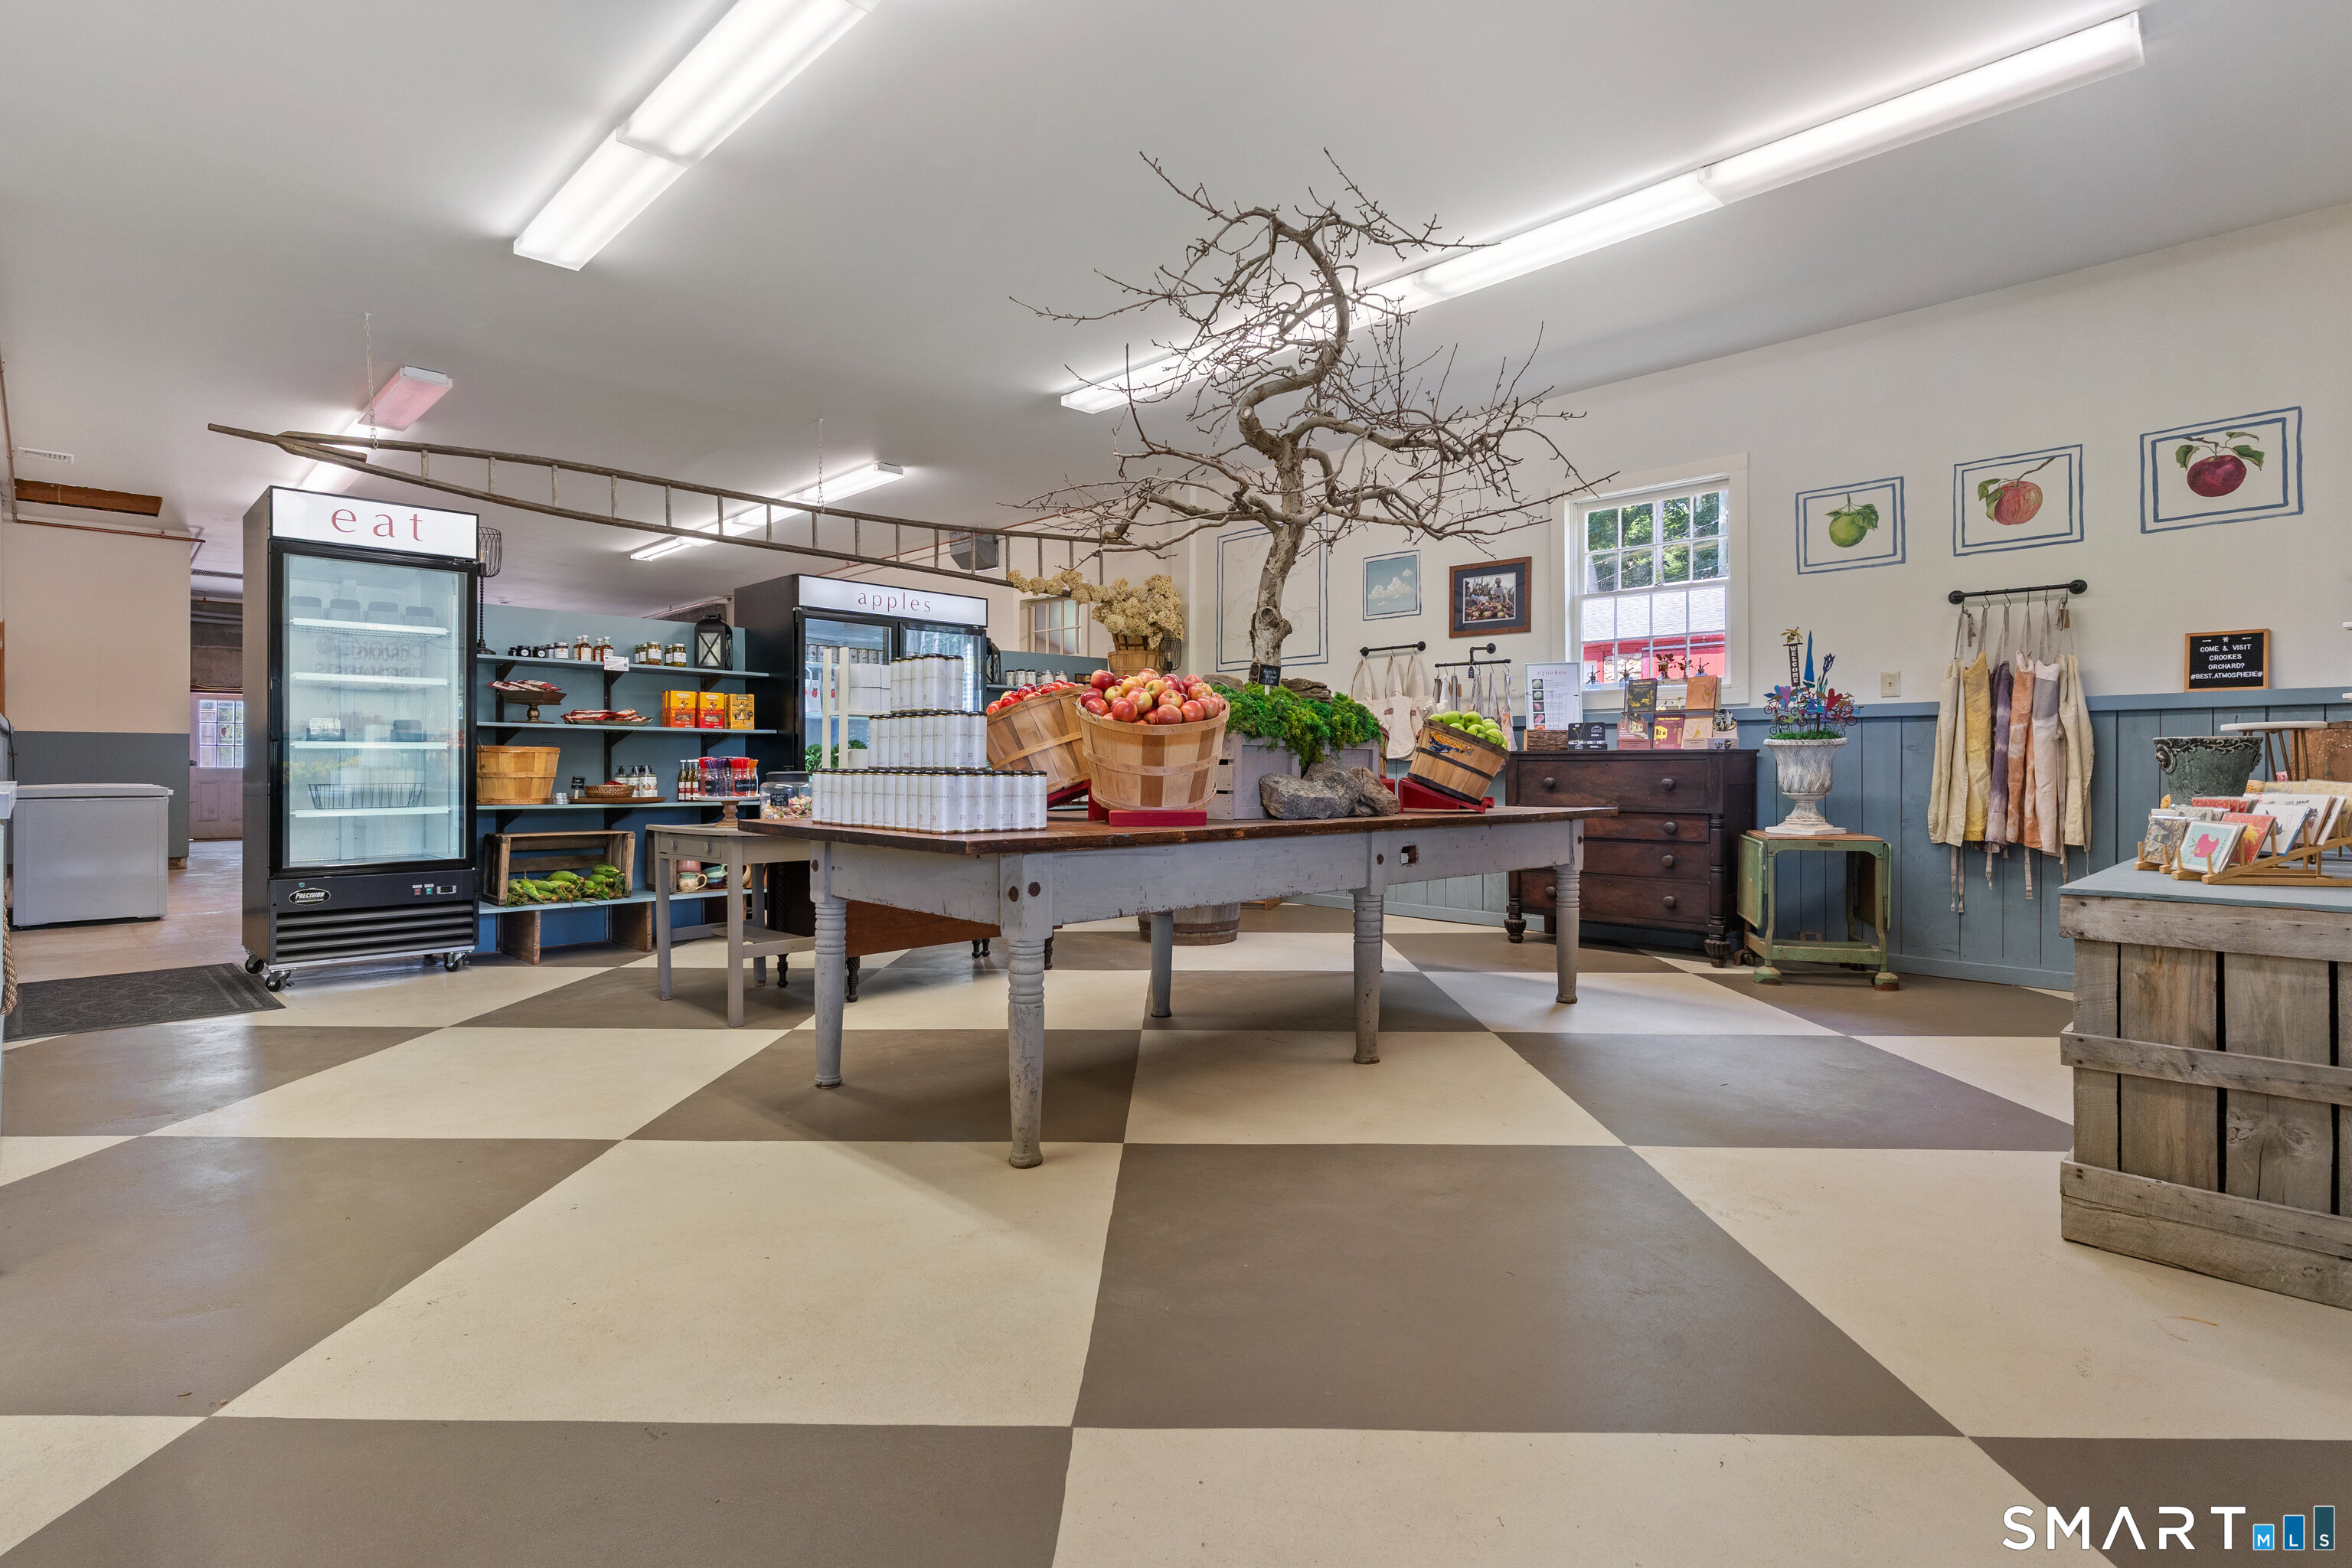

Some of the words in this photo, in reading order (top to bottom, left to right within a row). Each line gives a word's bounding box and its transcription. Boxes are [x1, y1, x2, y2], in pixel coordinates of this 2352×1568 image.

[331, 508, 425, 542] eat
[858, 592, 931, 612] apples
[1789, 645, 1799, 683] WELCOME
[2190, 671, 2263, 680] #BEST.ATMOSPHERE#
